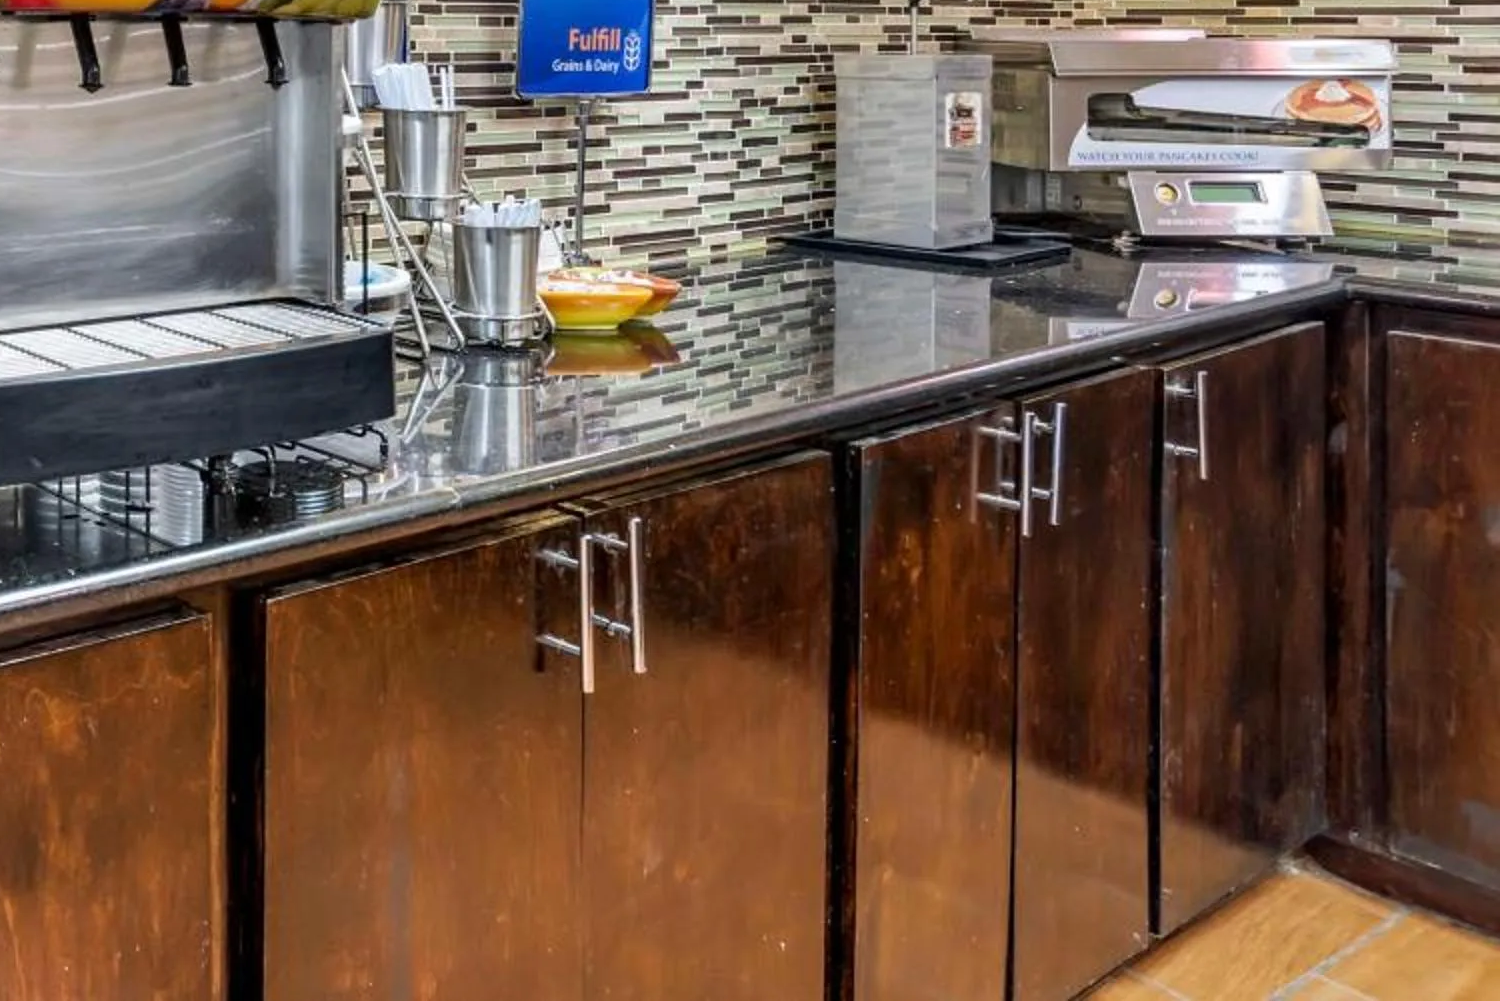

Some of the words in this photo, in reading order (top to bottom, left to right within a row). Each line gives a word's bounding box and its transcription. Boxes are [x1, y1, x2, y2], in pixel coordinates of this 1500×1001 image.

[568, 26, 622, 52] Fulfill
[551, 58, 583, 73] Grains
[593, 59, 621, 75] Dairy
